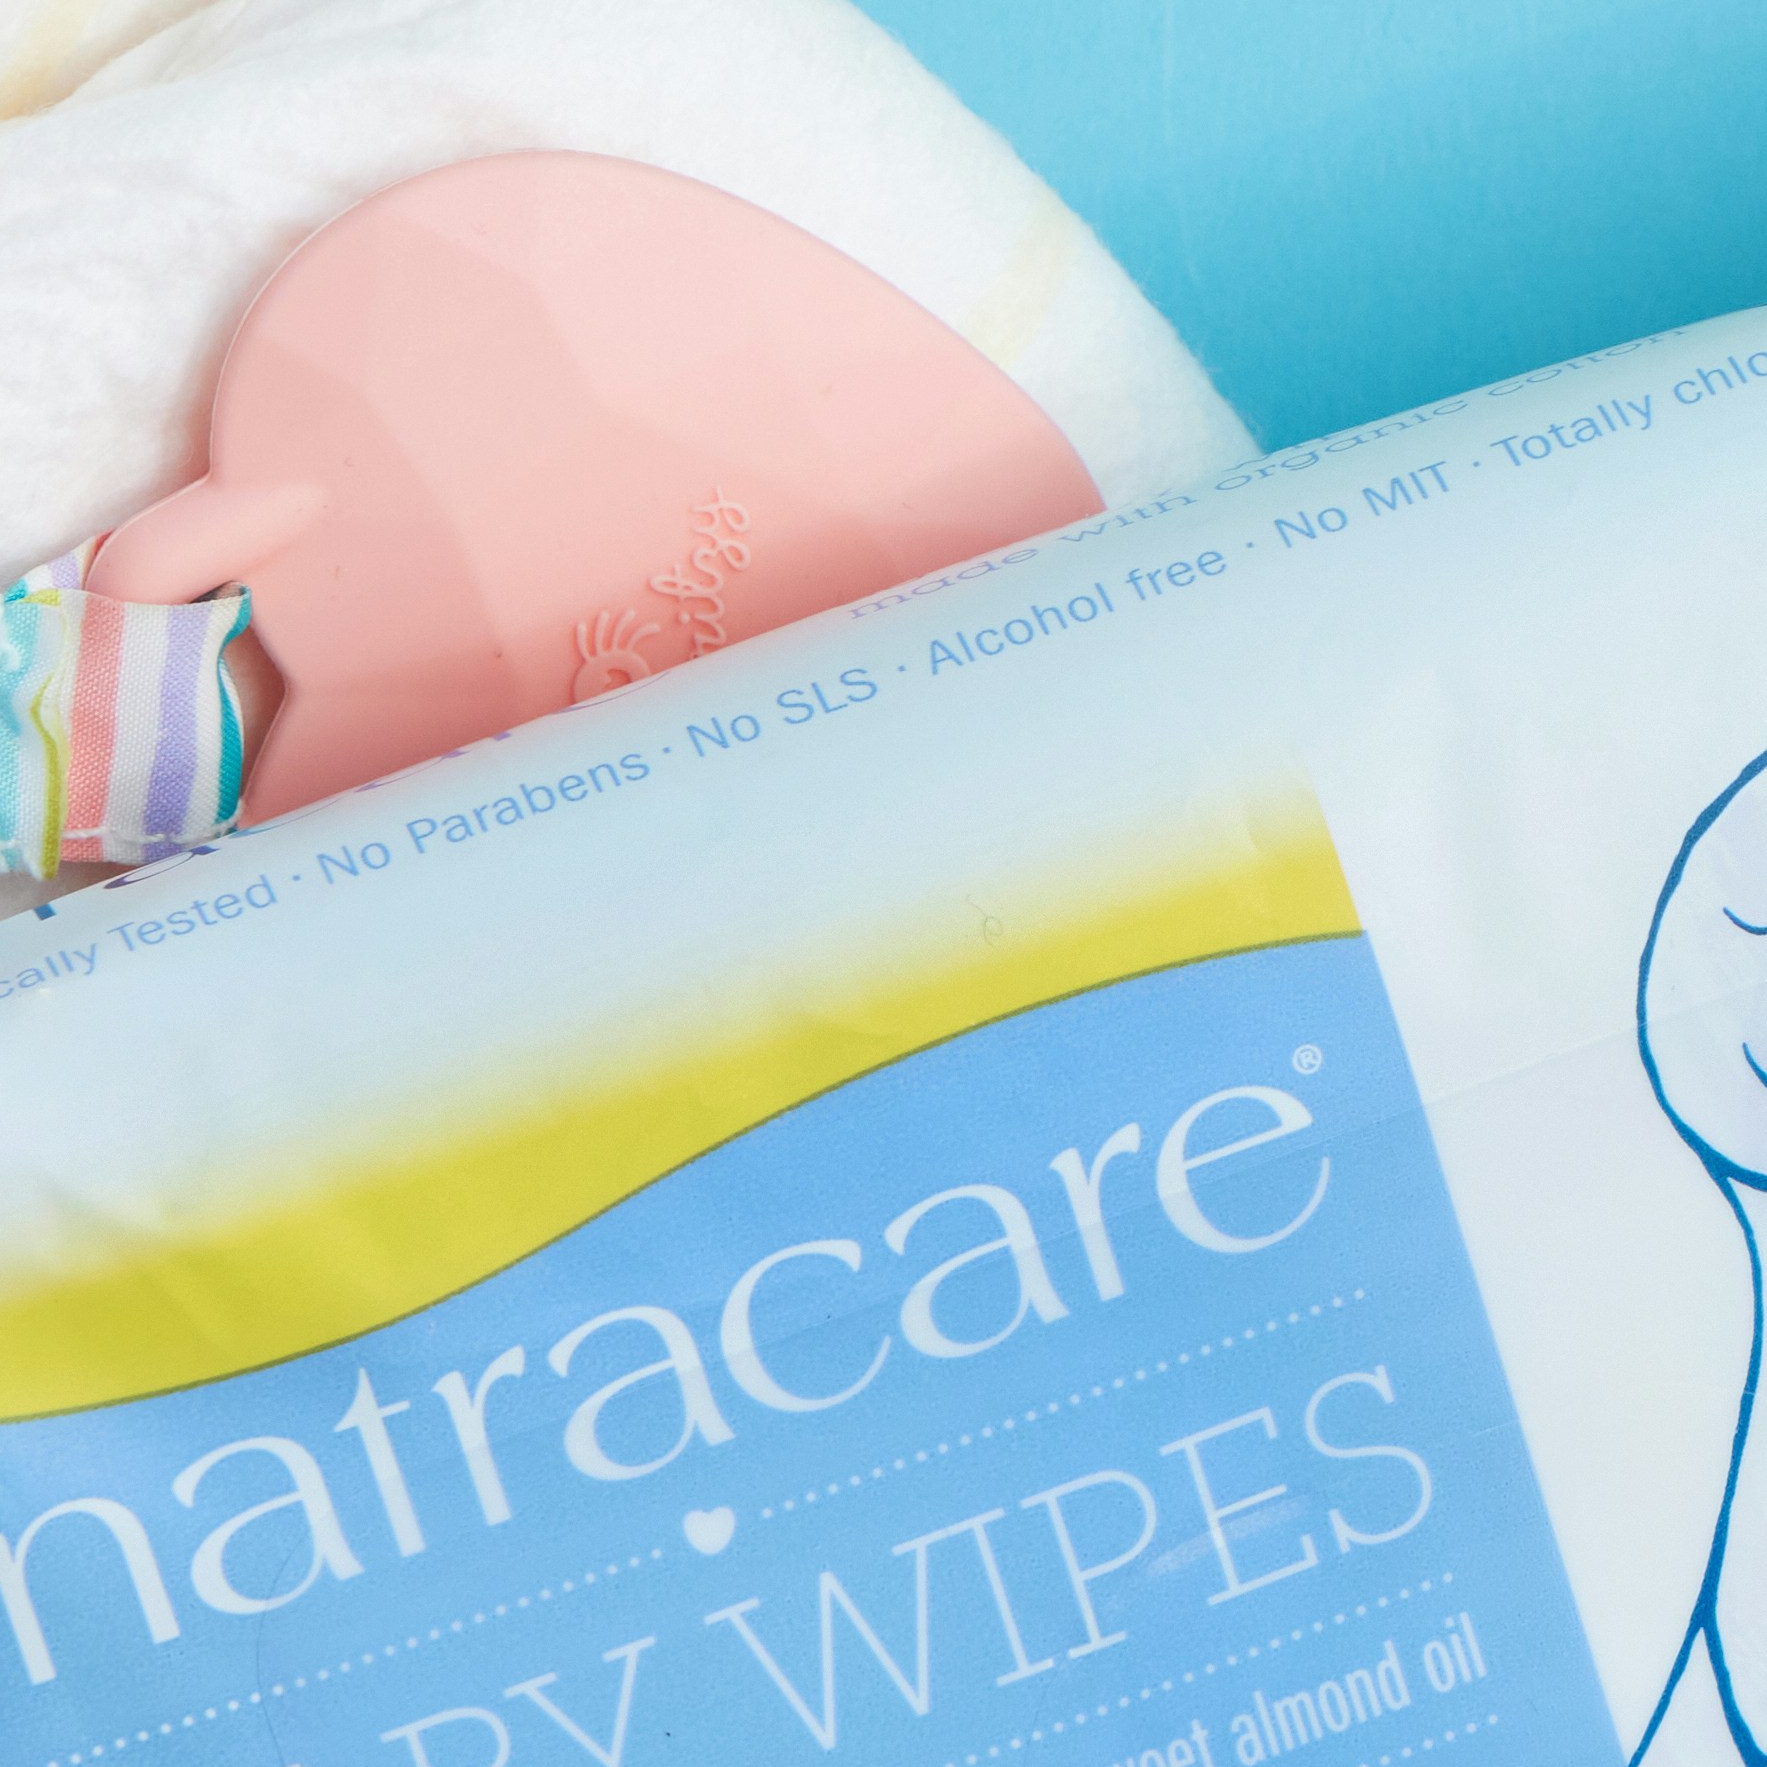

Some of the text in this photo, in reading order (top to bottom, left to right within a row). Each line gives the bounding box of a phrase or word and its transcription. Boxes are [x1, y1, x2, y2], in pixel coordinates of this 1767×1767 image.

[849, 547, 1039, 620] made
[1215, 398, 1469, 492] organic
[107, 874, 278, 952] Tested
[315, 842, 392, 884] No
[405, 751, 651, 855] Parabens
[685, 713, 761, 757] No
[775, 667, 878, 725] SLS
[928, 582, 1114, 675] Alcohol
[1125, 550, 1228, 601] free
[1273, 507, 1348, 549] No
[1361, 461, 1452, 517] MIT
[1489, 395, 1654, 468] Totally
[704, 1363, 1434, 1752] WIPES
[1234, 1639, 1412, 1767] almond
[1422, 1611, 1488, 1694] oil
